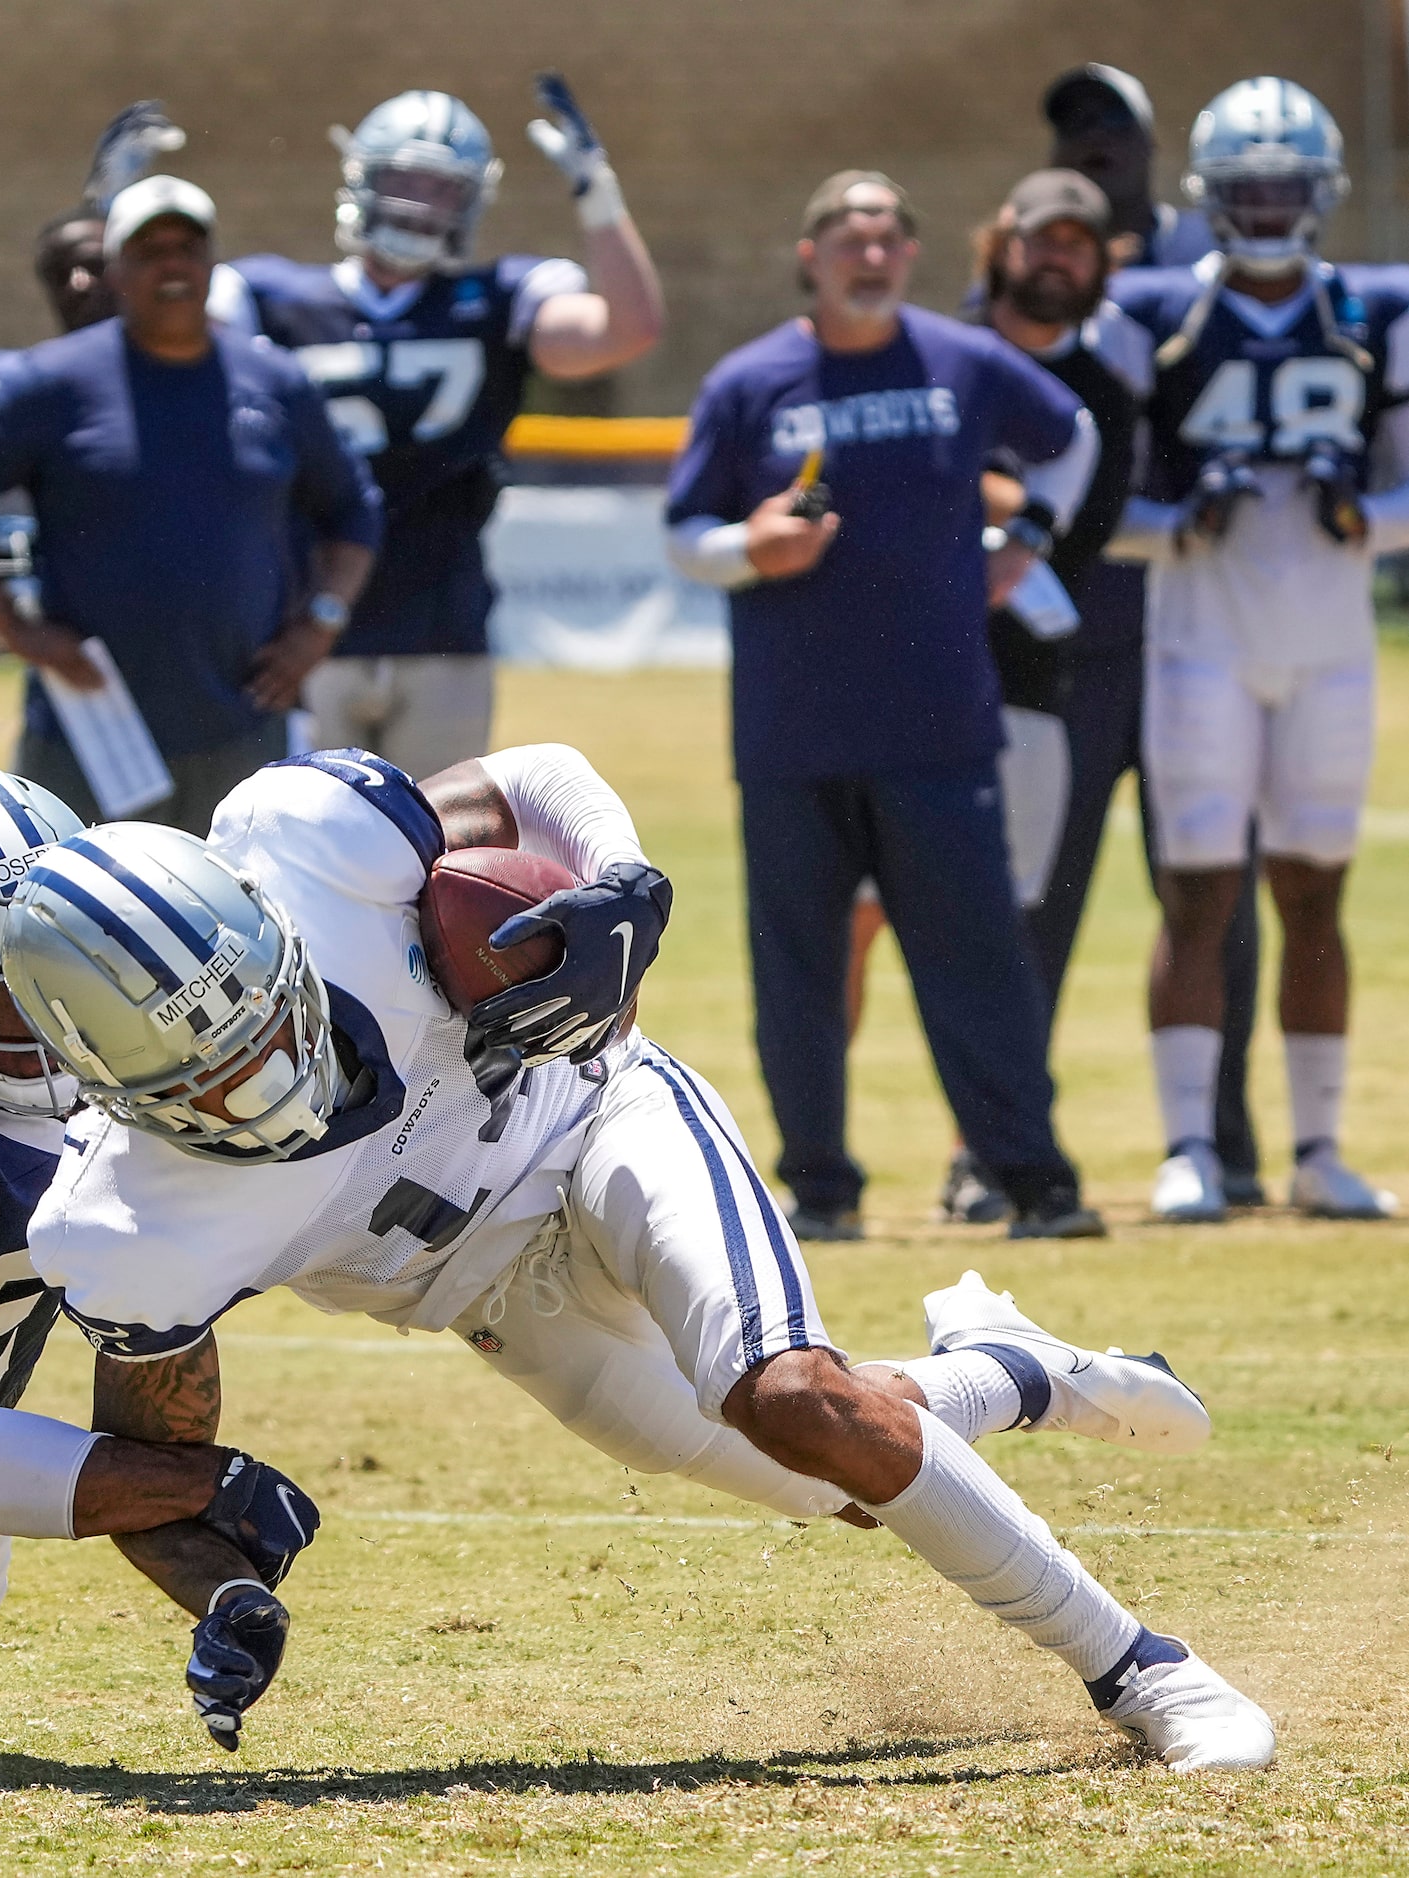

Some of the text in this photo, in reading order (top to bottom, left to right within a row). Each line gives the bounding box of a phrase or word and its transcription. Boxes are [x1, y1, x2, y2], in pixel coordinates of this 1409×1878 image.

[772, 388, 960, 456] COWBOYS
[1179, 358, 1364, 452] 48
[157, 944, 244, 1026] MITCHELL
[475, 947, 513, 987] NATIONA
[211, 1005, 247, 1039] COWBOYS
[392, 1077, 440, 1155] COWBOYS
